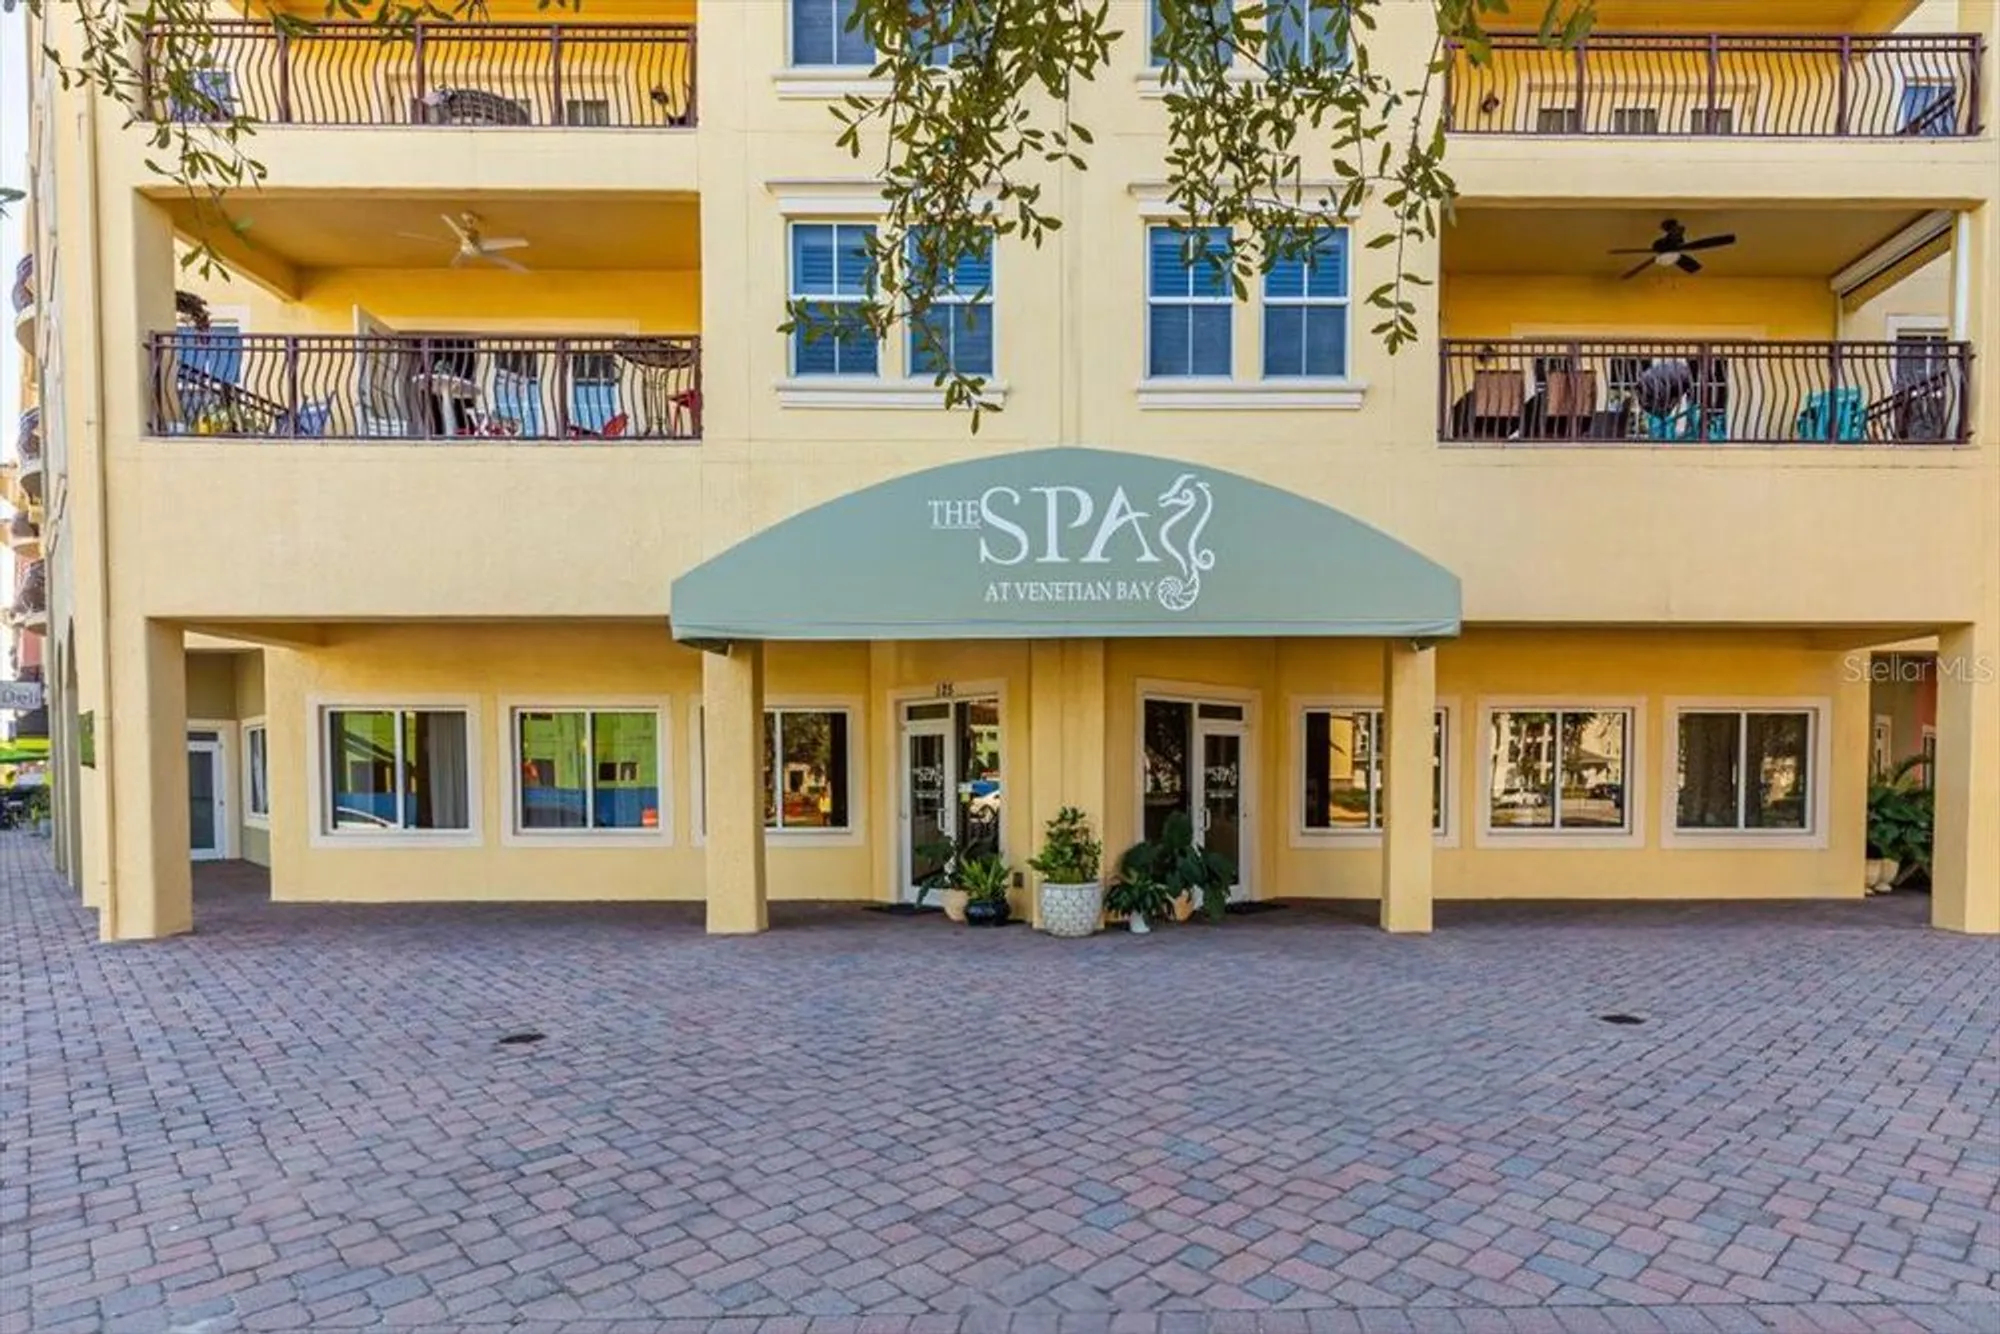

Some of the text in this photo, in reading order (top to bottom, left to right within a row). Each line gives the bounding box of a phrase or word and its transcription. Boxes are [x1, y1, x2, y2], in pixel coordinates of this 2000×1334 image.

[928, 484, 1161, 566] THE SPA
[985, 580, 1153, 602] AT VENETIAN BAY
[935, 683, 955, 698] 125
